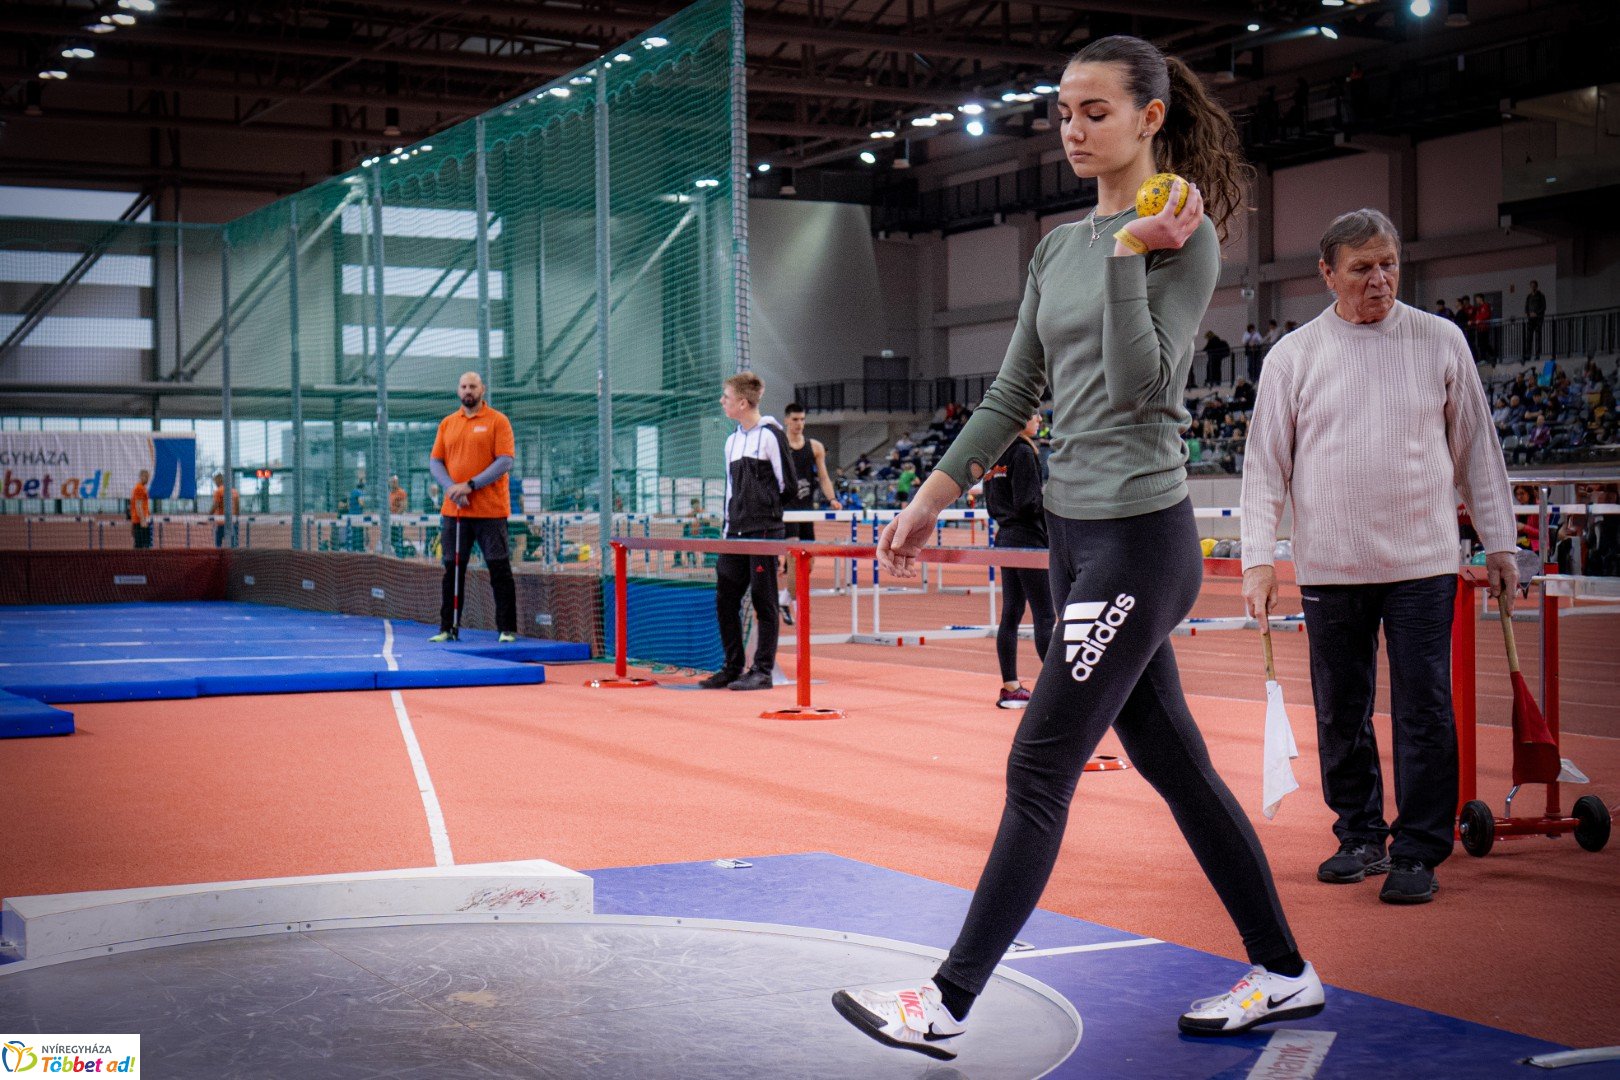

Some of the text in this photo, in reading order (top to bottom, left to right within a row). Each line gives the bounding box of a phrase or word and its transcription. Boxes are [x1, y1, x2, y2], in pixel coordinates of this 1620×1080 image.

[0, 469, 112, 499] bet ad!
[1071, 593, 1136, 682] adidas
